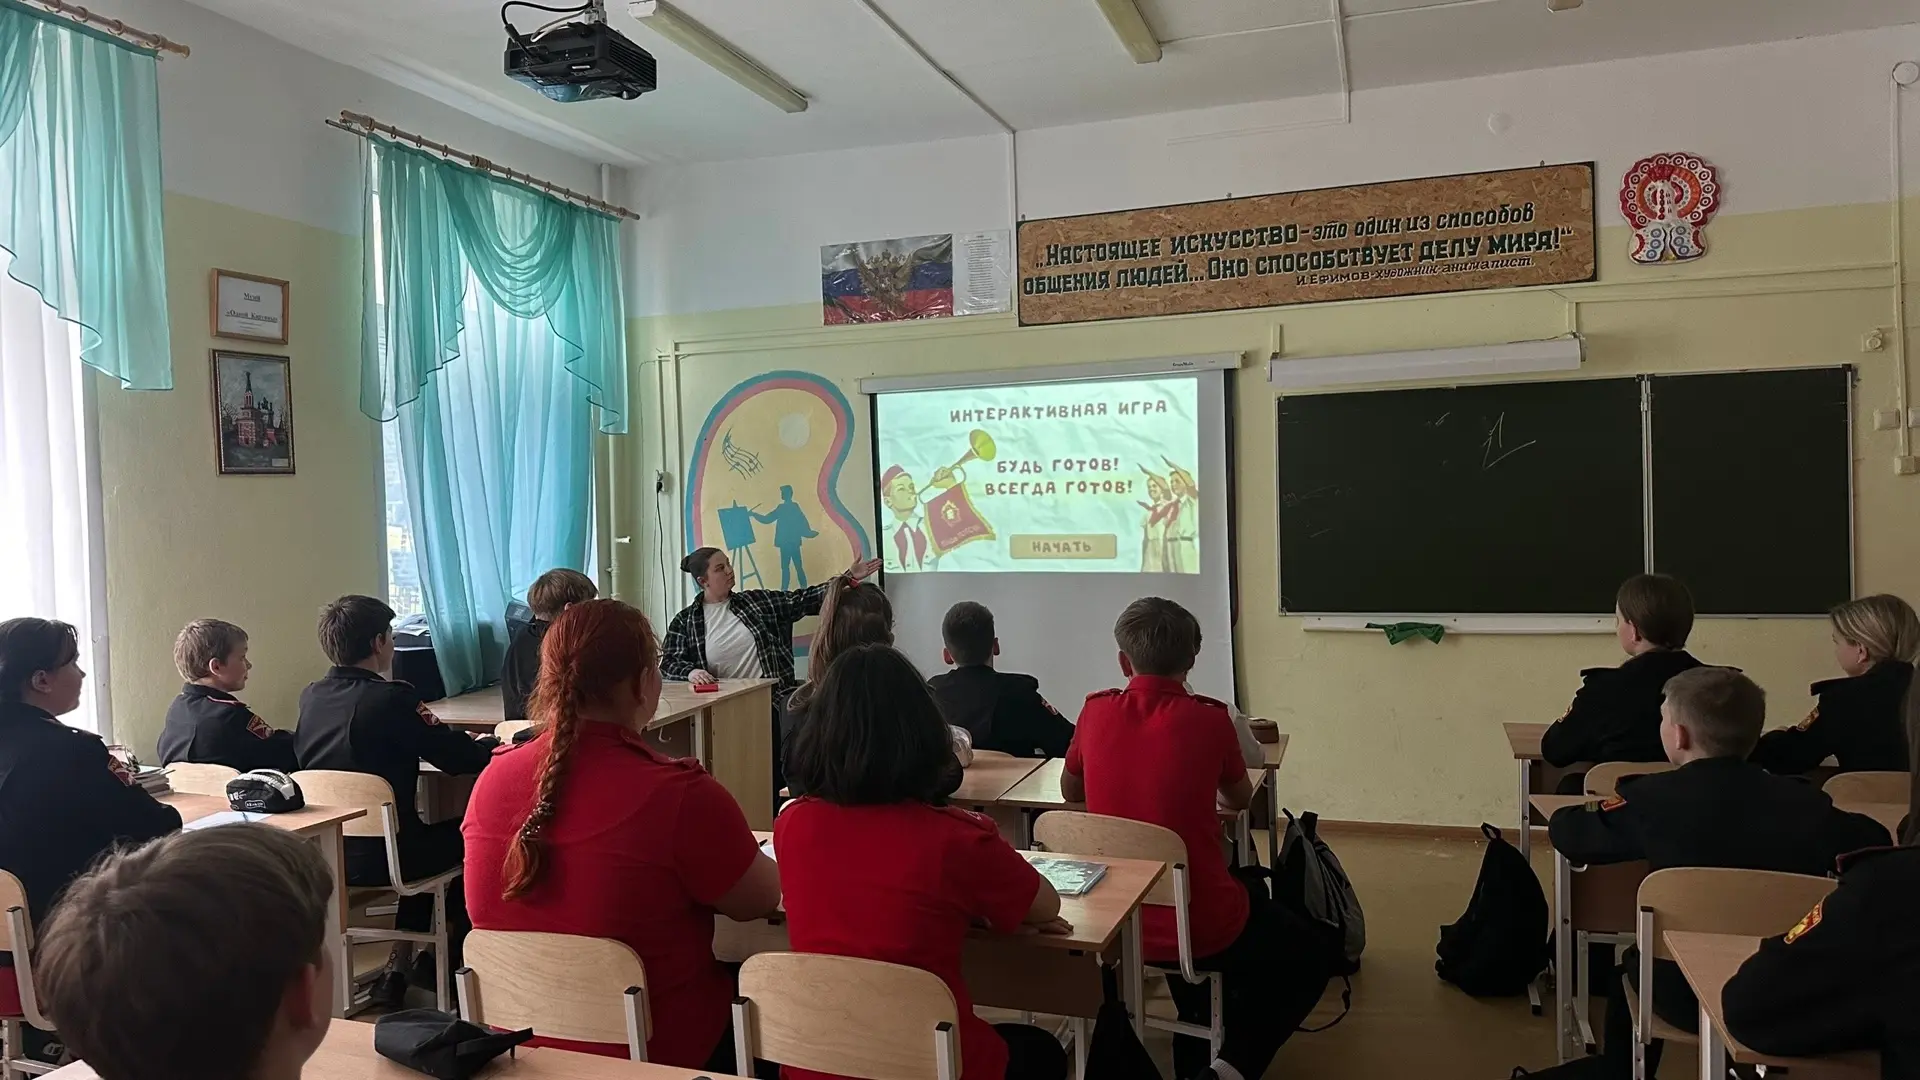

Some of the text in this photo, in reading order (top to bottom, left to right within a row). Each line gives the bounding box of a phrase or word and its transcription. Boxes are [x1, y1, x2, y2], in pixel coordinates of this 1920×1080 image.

[1354, 215, 1400, 238] один
[1406, 215, 1431, 233] из
[1436, 202, 1535, 230] способов
[1023, 270, 1112, 296] ОБЩЕНИЯ
[1255, 242, 1414, 276] СПОСОБСТВУЕТ
[1419, 236, 1482, 264] ДЕЛУ
[949, 399, 1168, 423] ИНТЕРАКТИВНАЯ ИГРА
[996, 457, 1120, 475] БУДЬ ГОТОВ!
[985, 480, 1133, 496] ВСЕГДА ГОТОВ!
[1031, 540, 1092, 555] НАЧАТЬ
